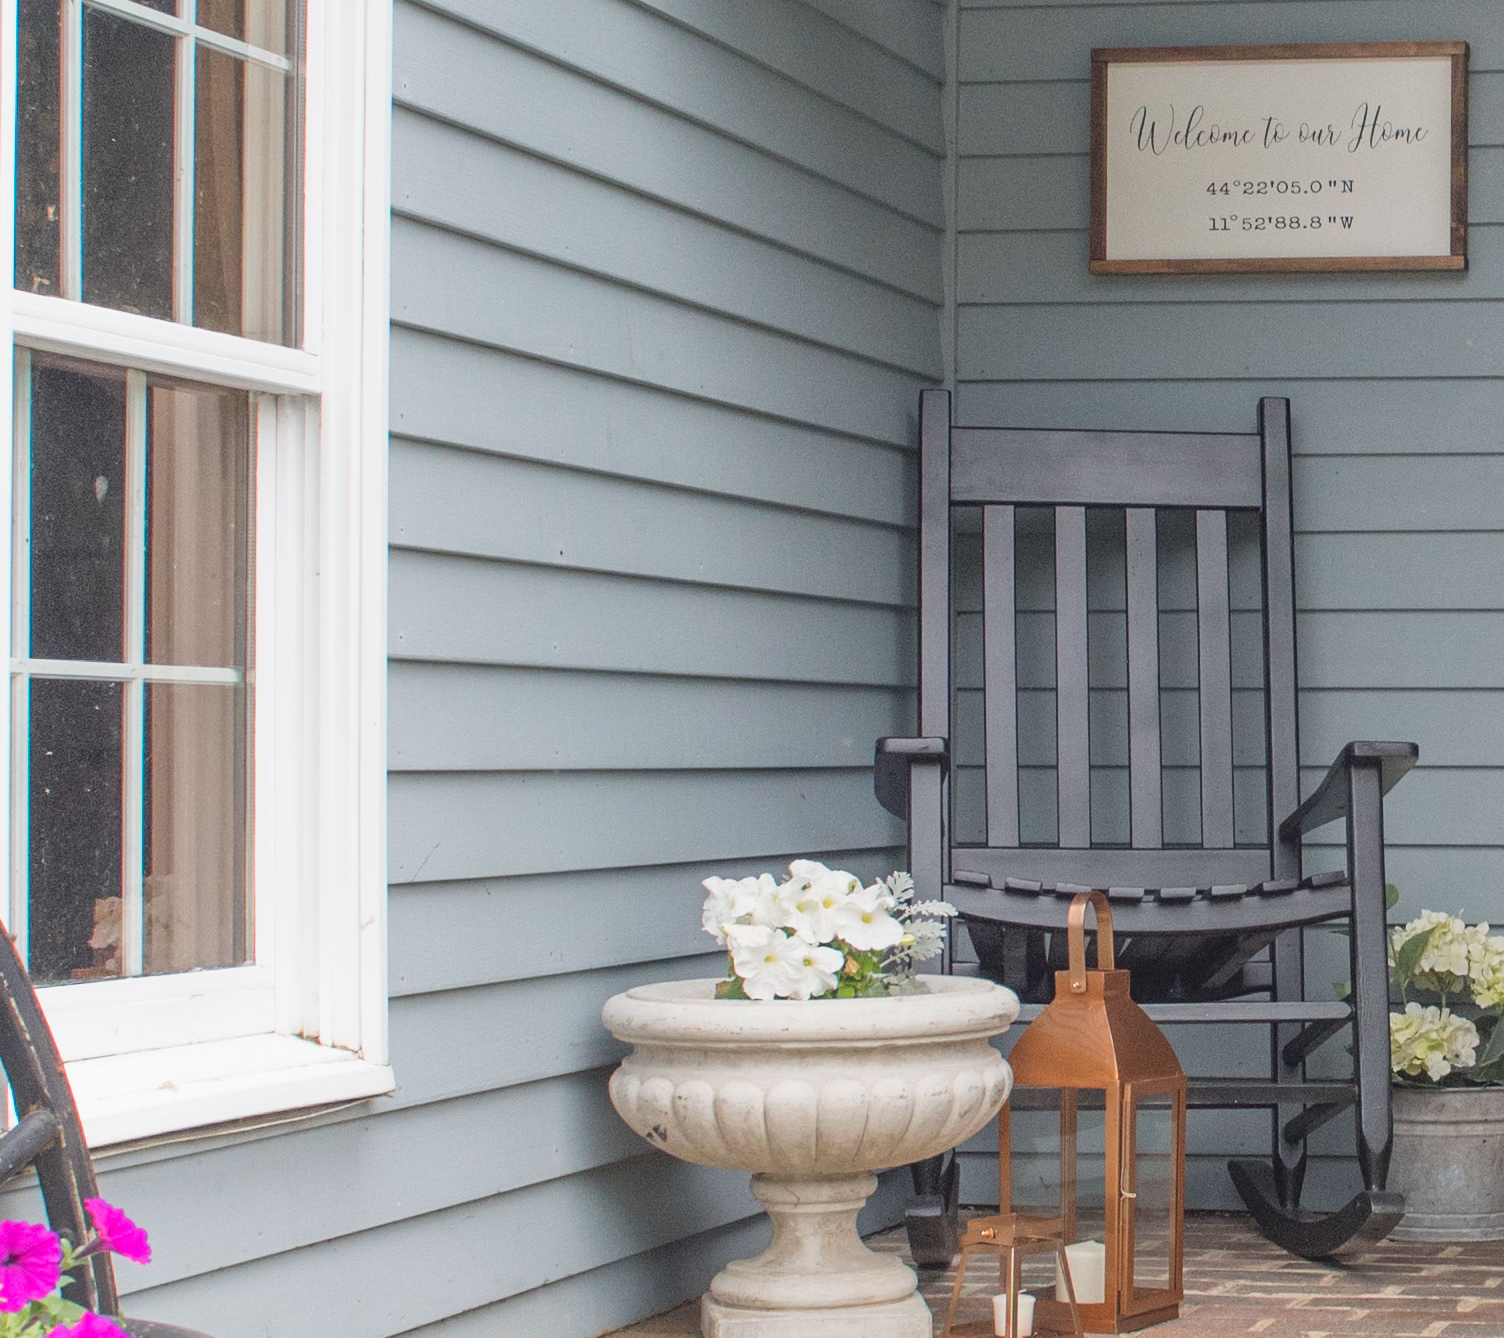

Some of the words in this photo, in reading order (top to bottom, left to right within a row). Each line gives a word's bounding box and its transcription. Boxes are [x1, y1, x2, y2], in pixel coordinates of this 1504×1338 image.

[1129, 103, 1255, 156] Welcome
[1262, 116, 1289, 149] to
[1298, 122, 1342, 146] our
[1347, 102, 1429, 154] Home
